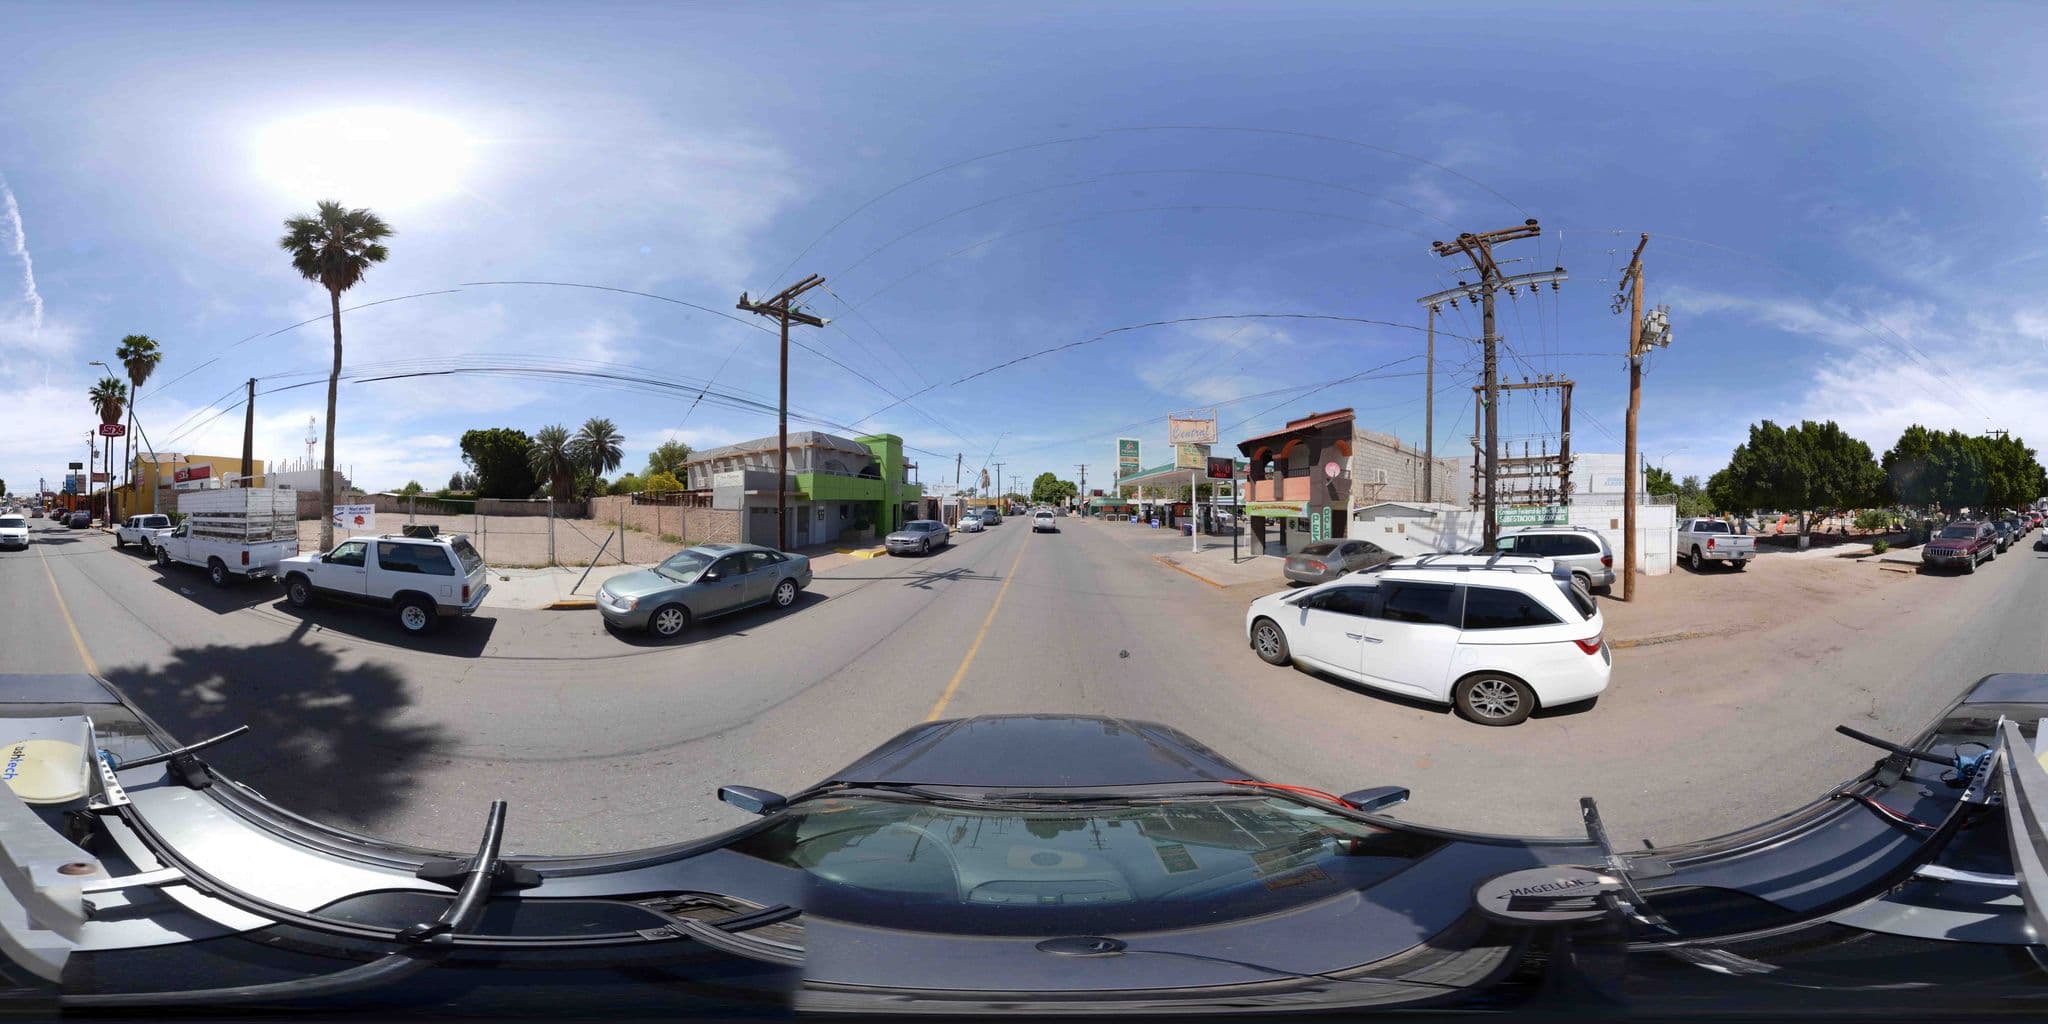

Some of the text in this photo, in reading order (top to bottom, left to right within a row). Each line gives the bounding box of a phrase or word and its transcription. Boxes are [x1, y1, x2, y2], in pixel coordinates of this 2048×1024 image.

[1173, 426, 1209, 440] Central
[3, 746, 26, 780] ashtech
[1509, 879, 1585, 896] MAGELLAN
